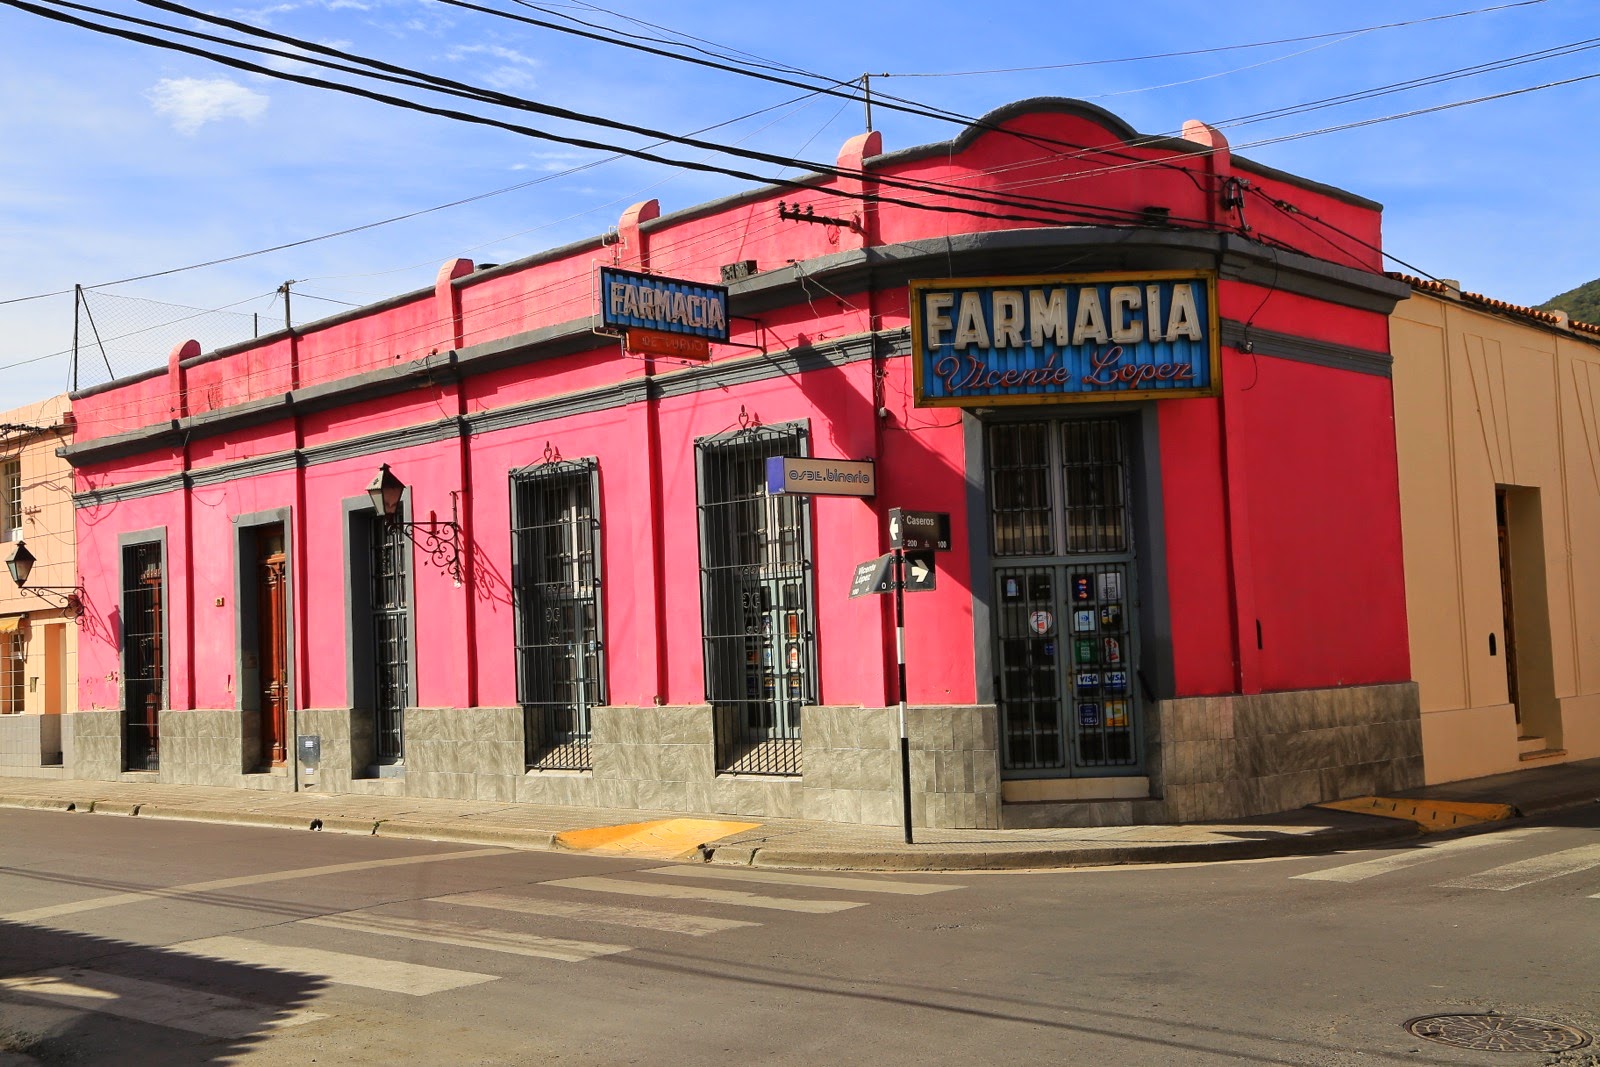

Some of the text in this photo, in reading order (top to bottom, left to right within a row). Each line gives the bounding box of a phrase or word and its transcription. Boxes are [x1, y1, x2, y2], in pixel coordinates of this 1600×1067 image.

[610, 281, 726, 331] FARMACIA
[926, 284, 1203, 350] FARMACIA
[934, 345, 1200, 393] Vicente Lopez
[906, 515, 935, 526] Caseros
[907, 539, 948, 549] 200 100
[1080, 674, 1098, 683] VISA
[1106, 673, 1125, 681] VISA
